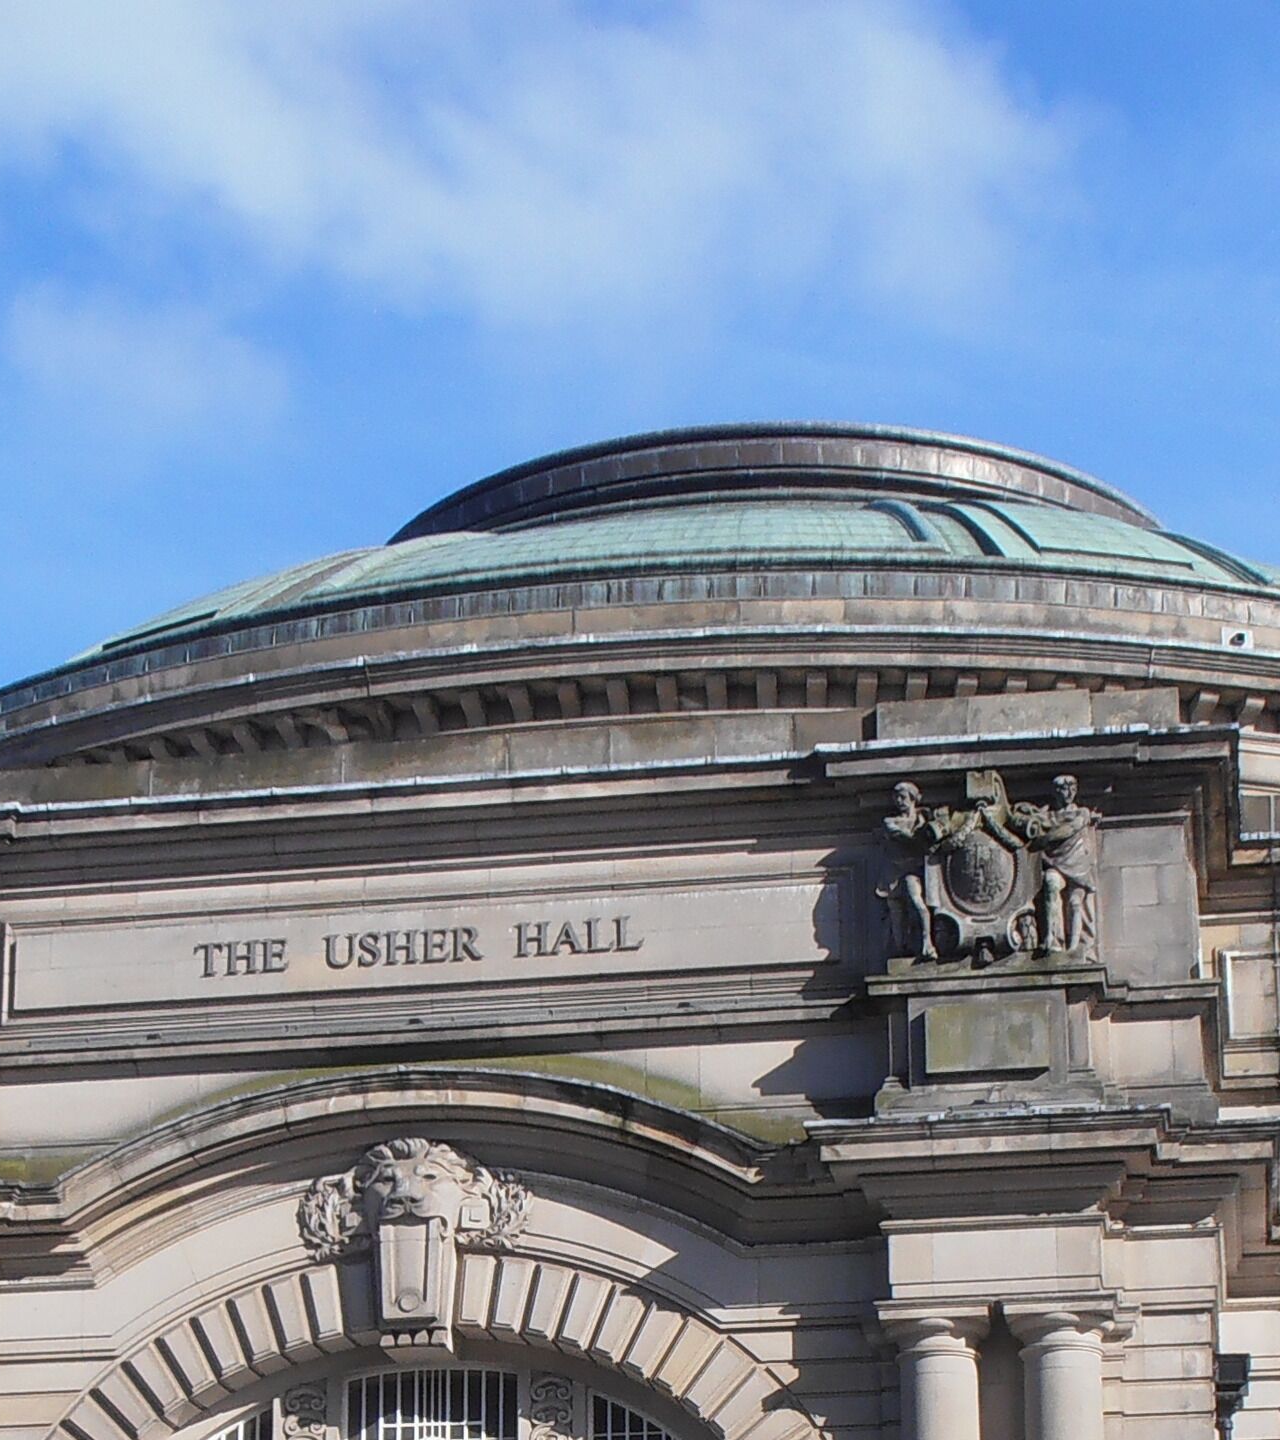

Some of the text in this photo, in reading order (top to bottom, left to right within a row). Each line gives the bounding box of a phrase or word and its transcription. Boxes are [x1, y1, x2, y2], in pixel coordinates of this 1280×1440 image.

[194, 915, 646, 978] THE USHER HALL
